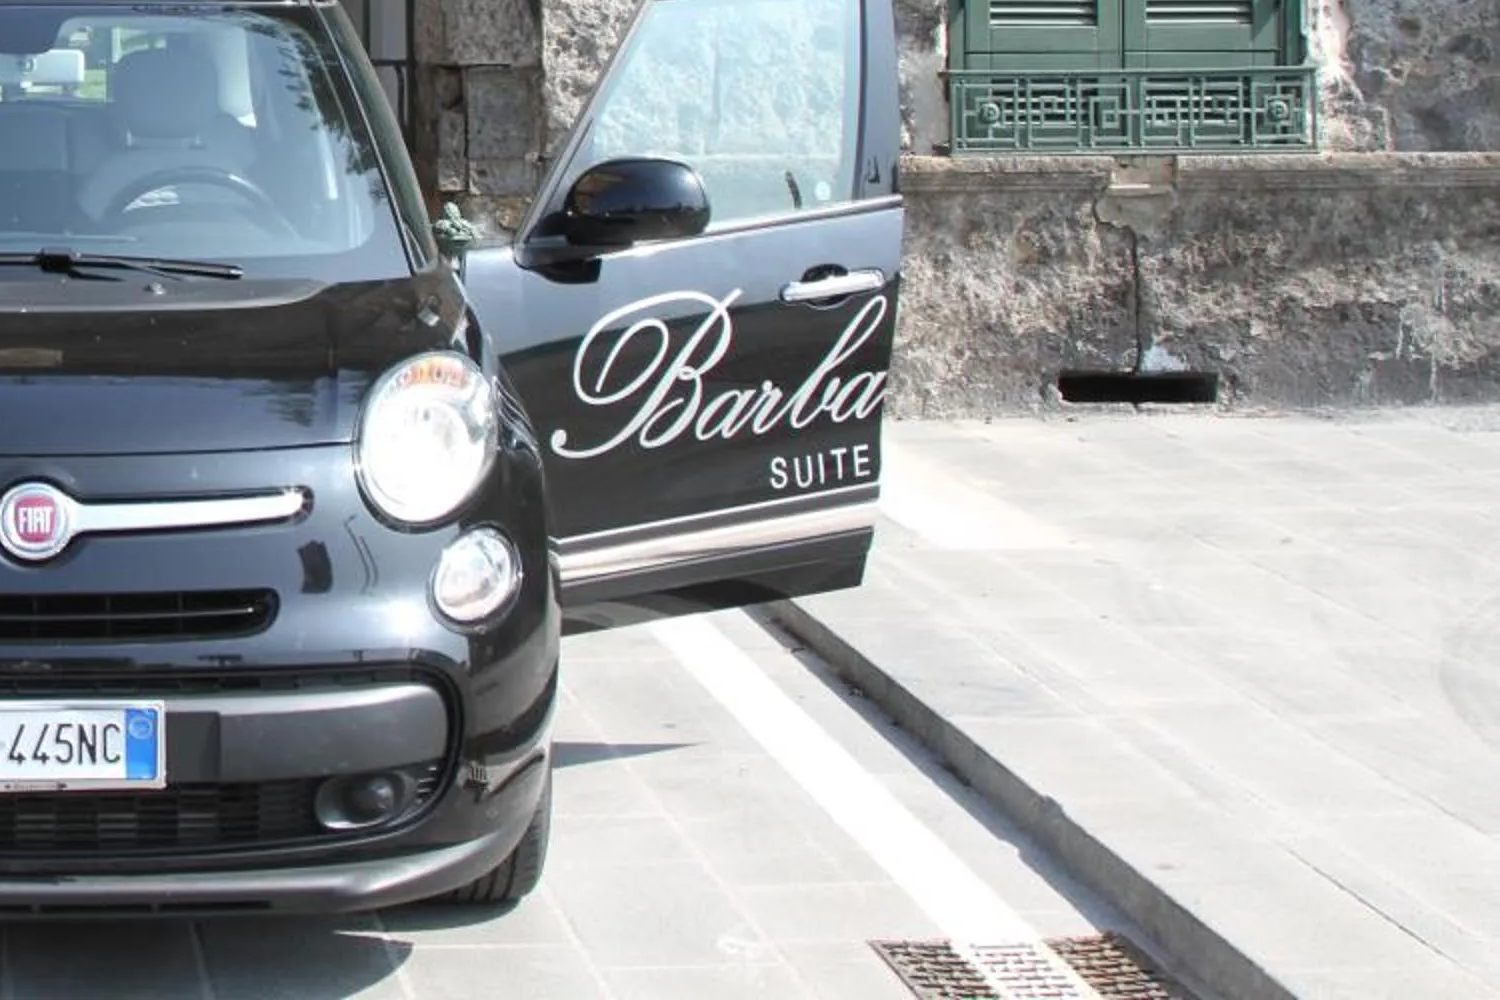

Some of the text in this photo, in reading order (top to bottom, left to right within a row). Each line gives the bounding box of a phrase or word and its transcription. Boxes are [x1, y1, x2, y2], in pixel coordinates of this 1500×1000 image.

[551, 288, 888, 459] Barba
[770, 444, 871, 490] SUITE
[18, 506, 53, 534] FIAT
[8, 723, 121, 765] 445NC
